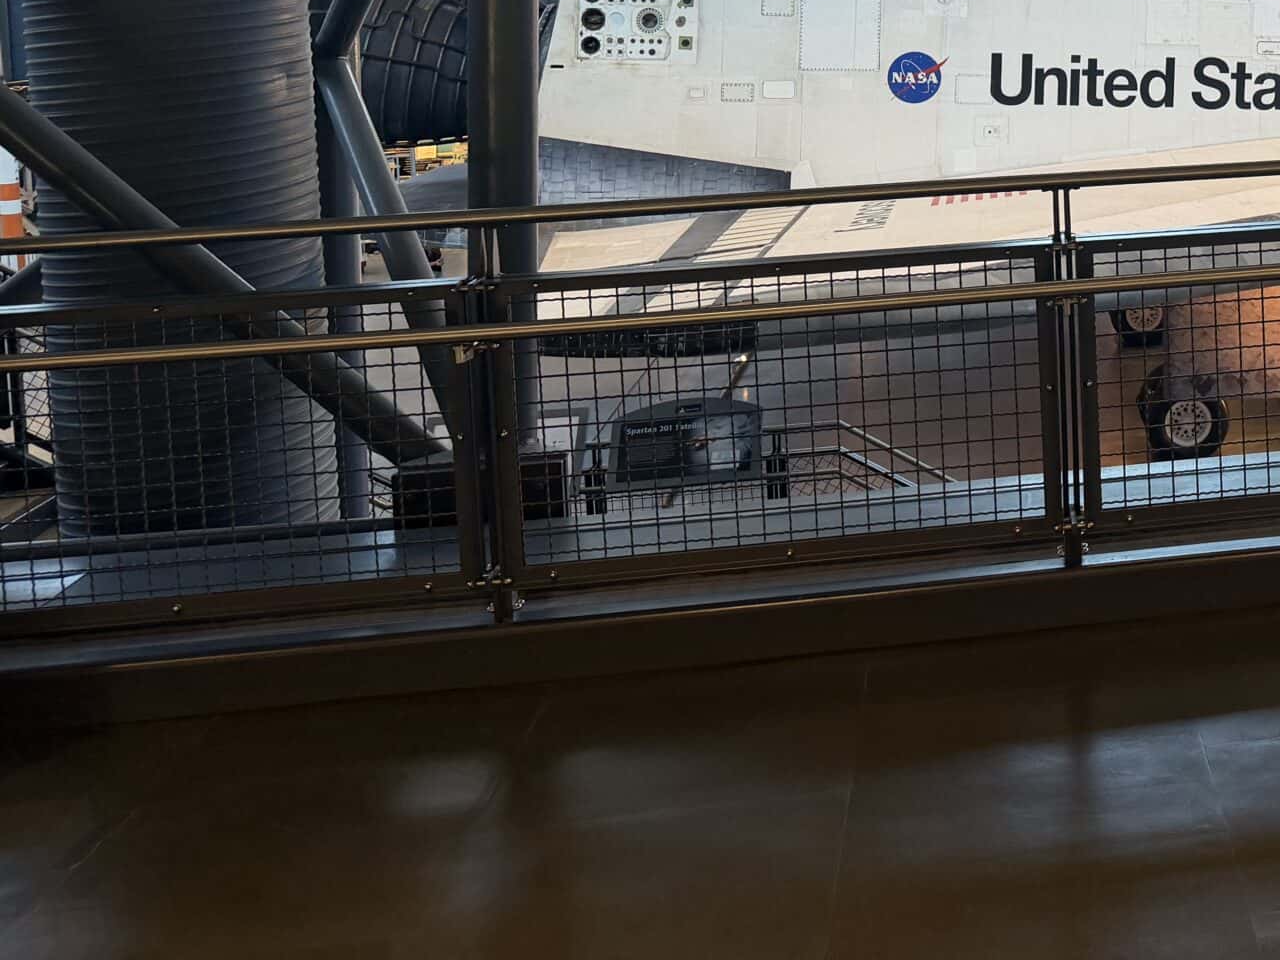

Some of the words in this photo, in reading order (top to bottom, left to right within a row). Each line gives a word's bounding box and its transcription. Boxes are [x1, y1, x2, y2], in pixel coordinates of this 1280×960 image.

[891, 71, 939, 84] NASA
[990, 52, 1176, 108] United
[626, 426, 657, 436] Spartan
[659, 424, 672, 433] 201
